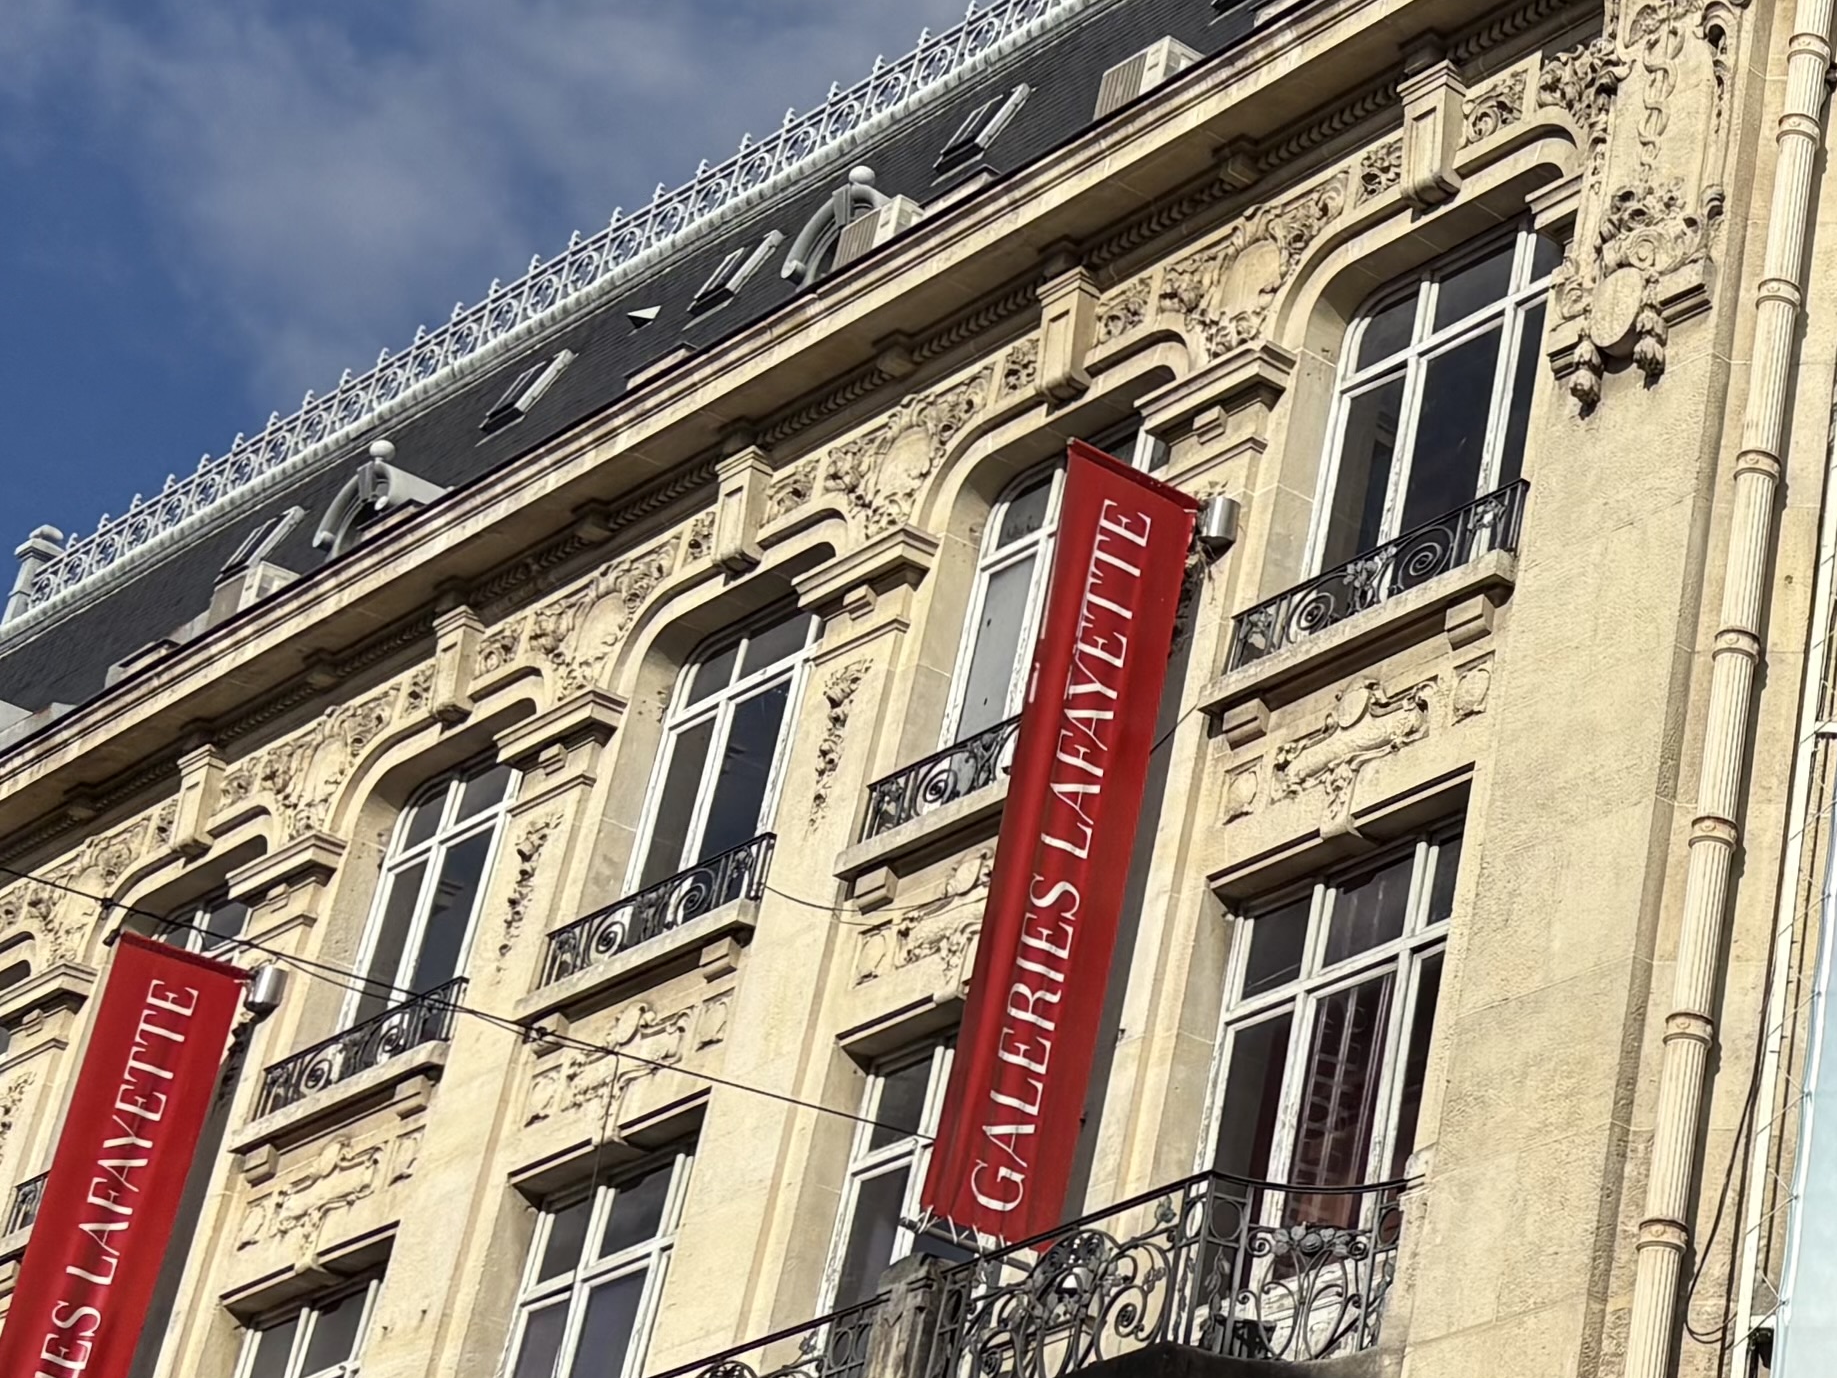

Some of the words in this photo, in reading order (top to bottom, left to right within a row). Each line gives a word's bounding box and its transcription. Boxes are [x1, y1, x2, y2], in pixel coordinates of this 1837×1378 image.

[970, 872, 1082, 1213] GALERIES
[1041, 498, 1152, 860] LAFAYETTE
[65, 977, 200, 1287] LAFAYETTE
